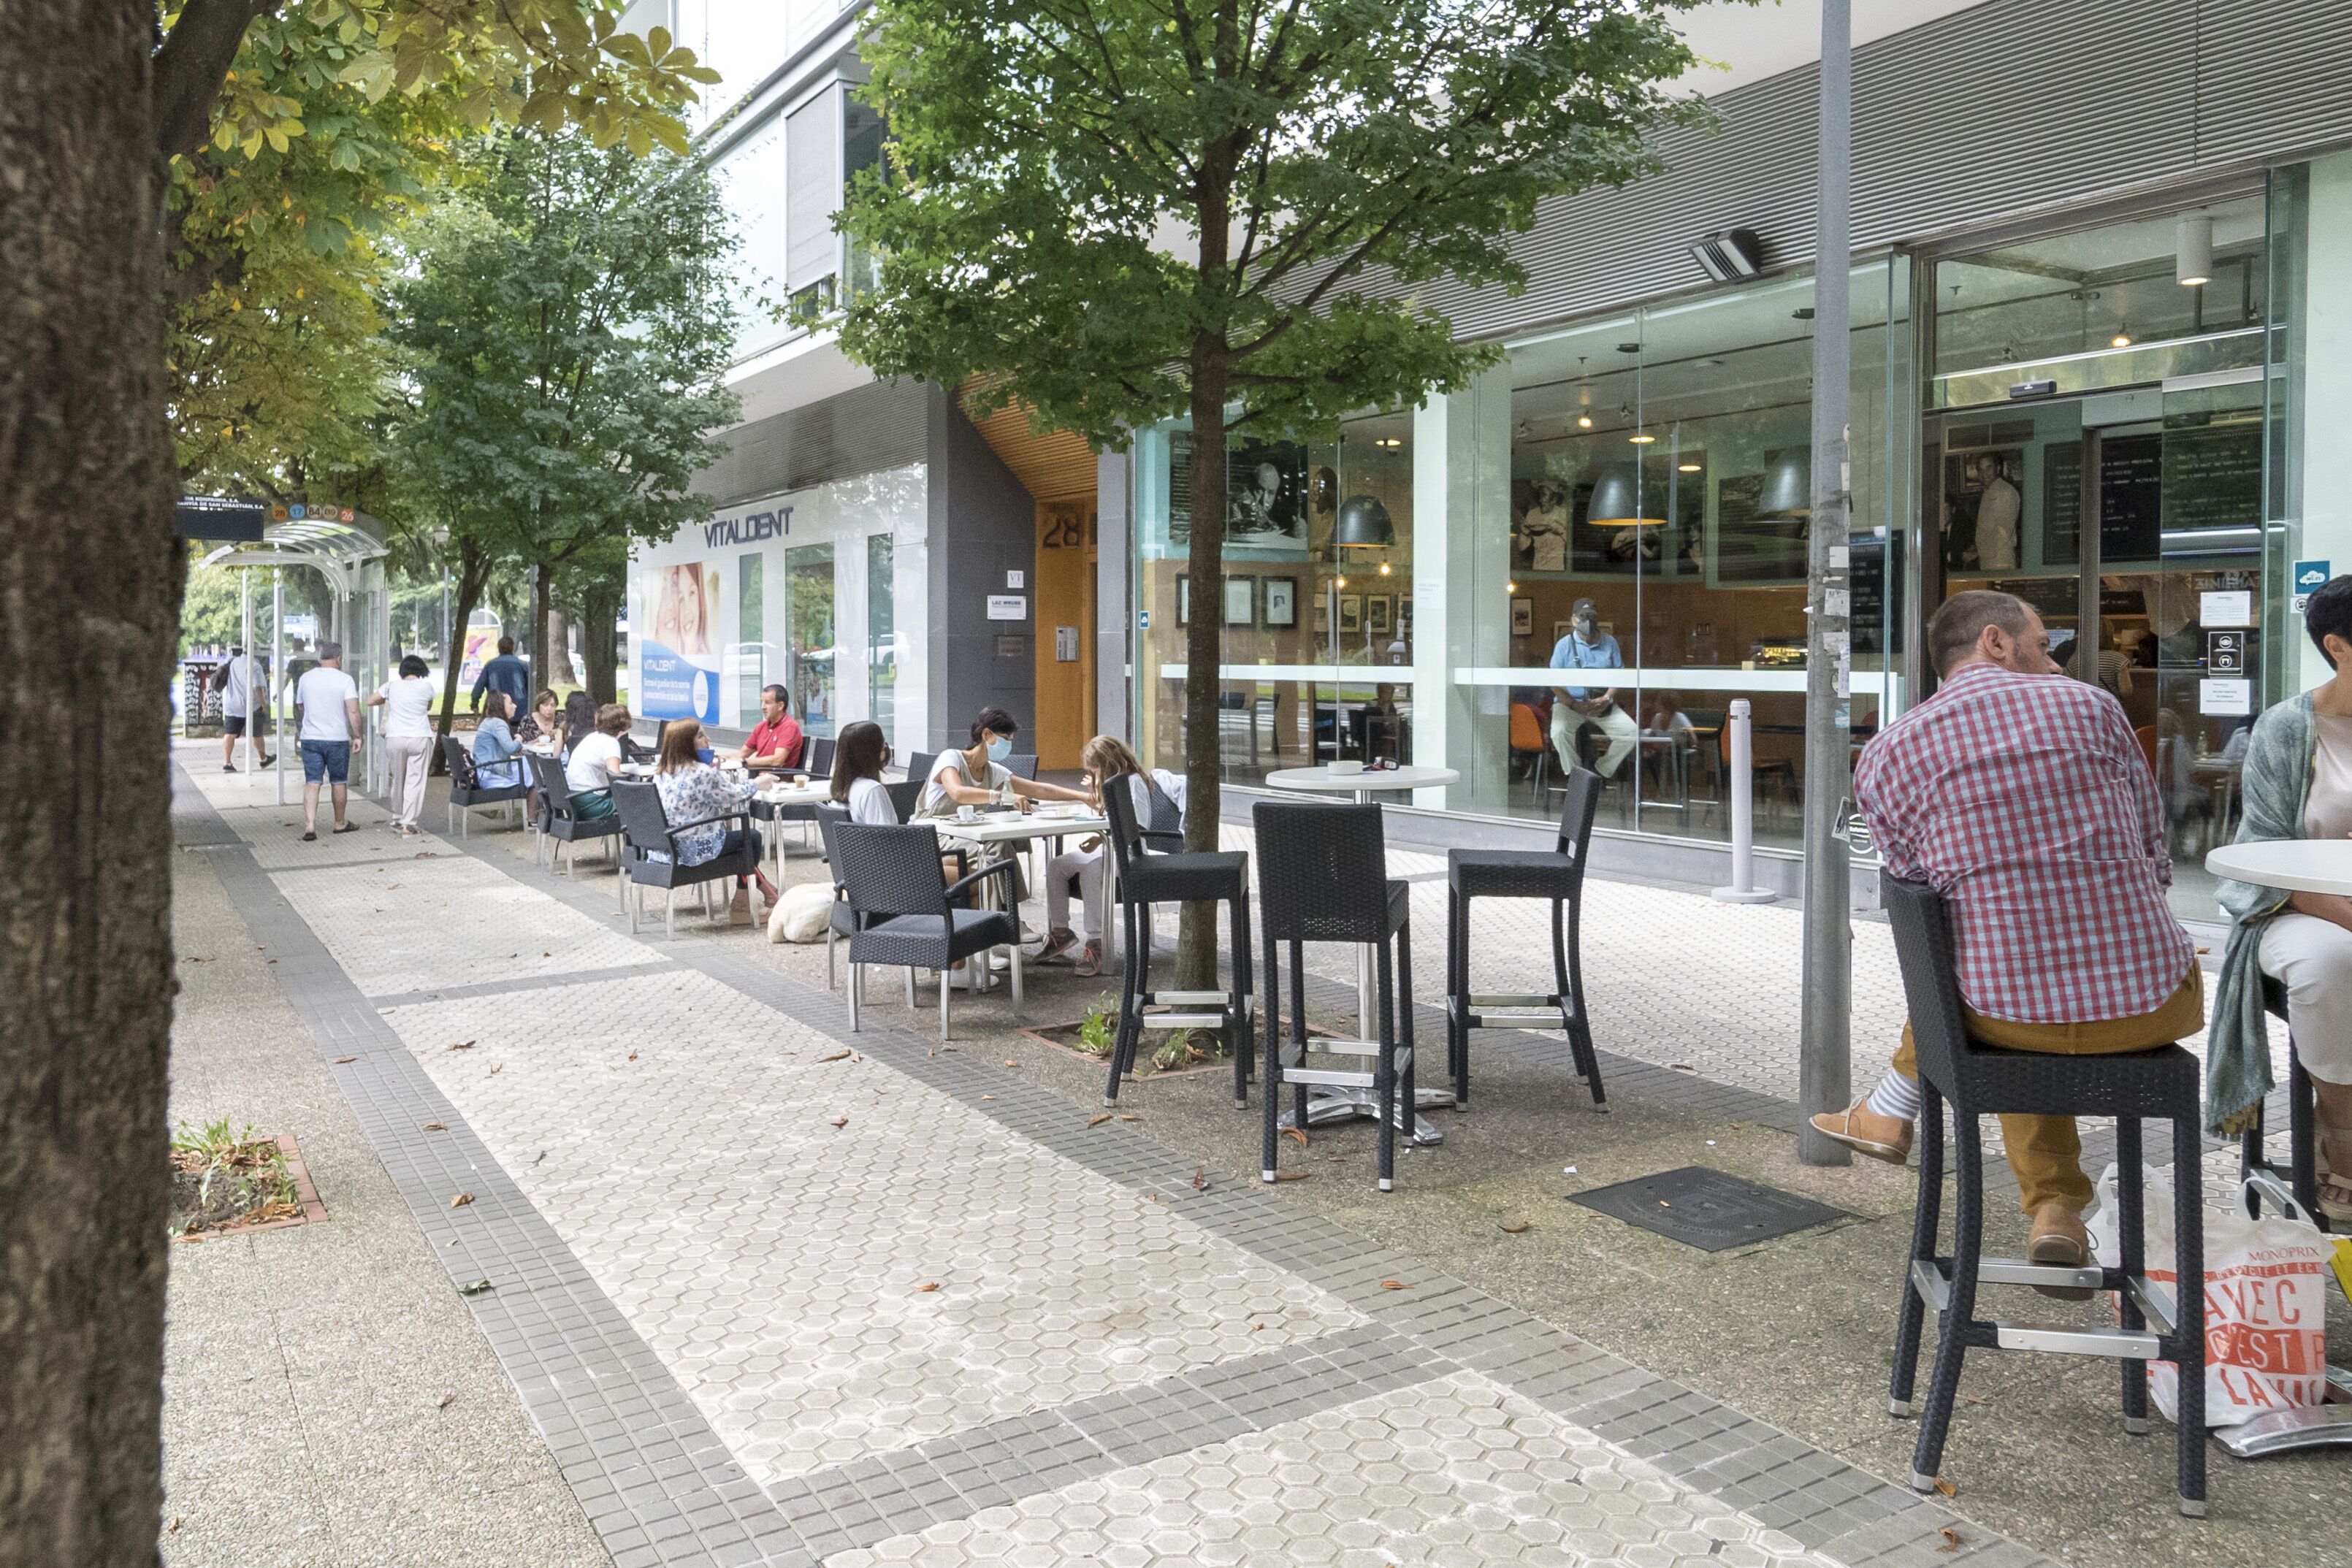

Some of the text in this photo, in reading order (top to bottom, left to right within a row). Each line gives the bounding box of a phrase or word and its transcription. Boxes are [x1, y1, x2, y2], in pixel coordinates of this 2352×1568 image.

[704, 507, 793, 548] VITALDENT
[1042, 511, 1080, 549] 28
[644, 659, 676, 671] VITALDENT
[2248, 1246, 2320, 1262] MONOPRIX
[2204, 1278, 2301, 1326] AVEC
[2207, 1325, 2291, 1371] C'EST
[2220, 1367, 2274, 1408] LA
